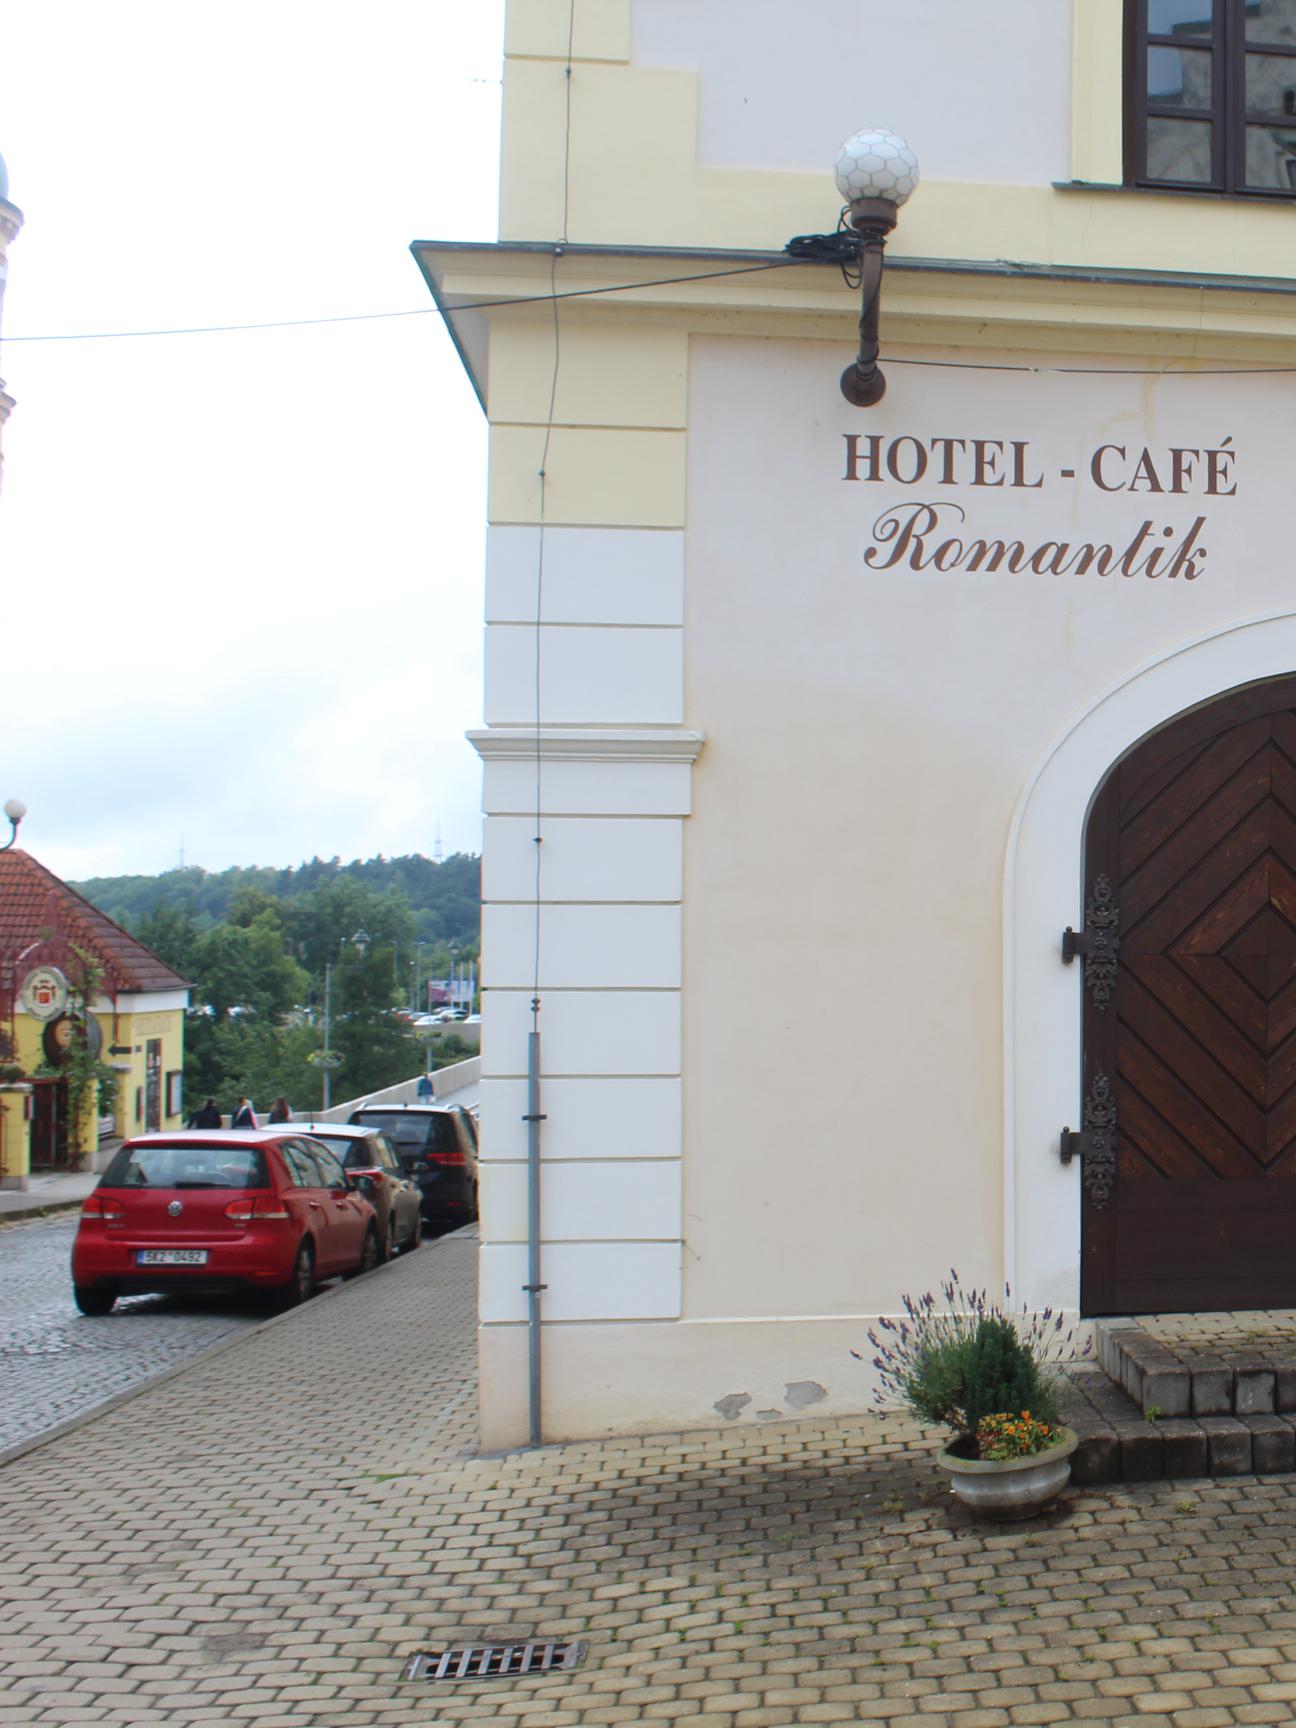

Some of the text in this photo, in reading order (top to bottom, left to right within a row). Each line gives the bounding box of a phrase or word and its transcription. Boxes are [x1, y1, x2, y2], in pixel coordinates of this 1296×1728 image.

[842, 433, 1044, 488] HOTEL
[1090, 436, 1238, 496] CAFÉ
[863, 502, 1207, 581] Romantik
